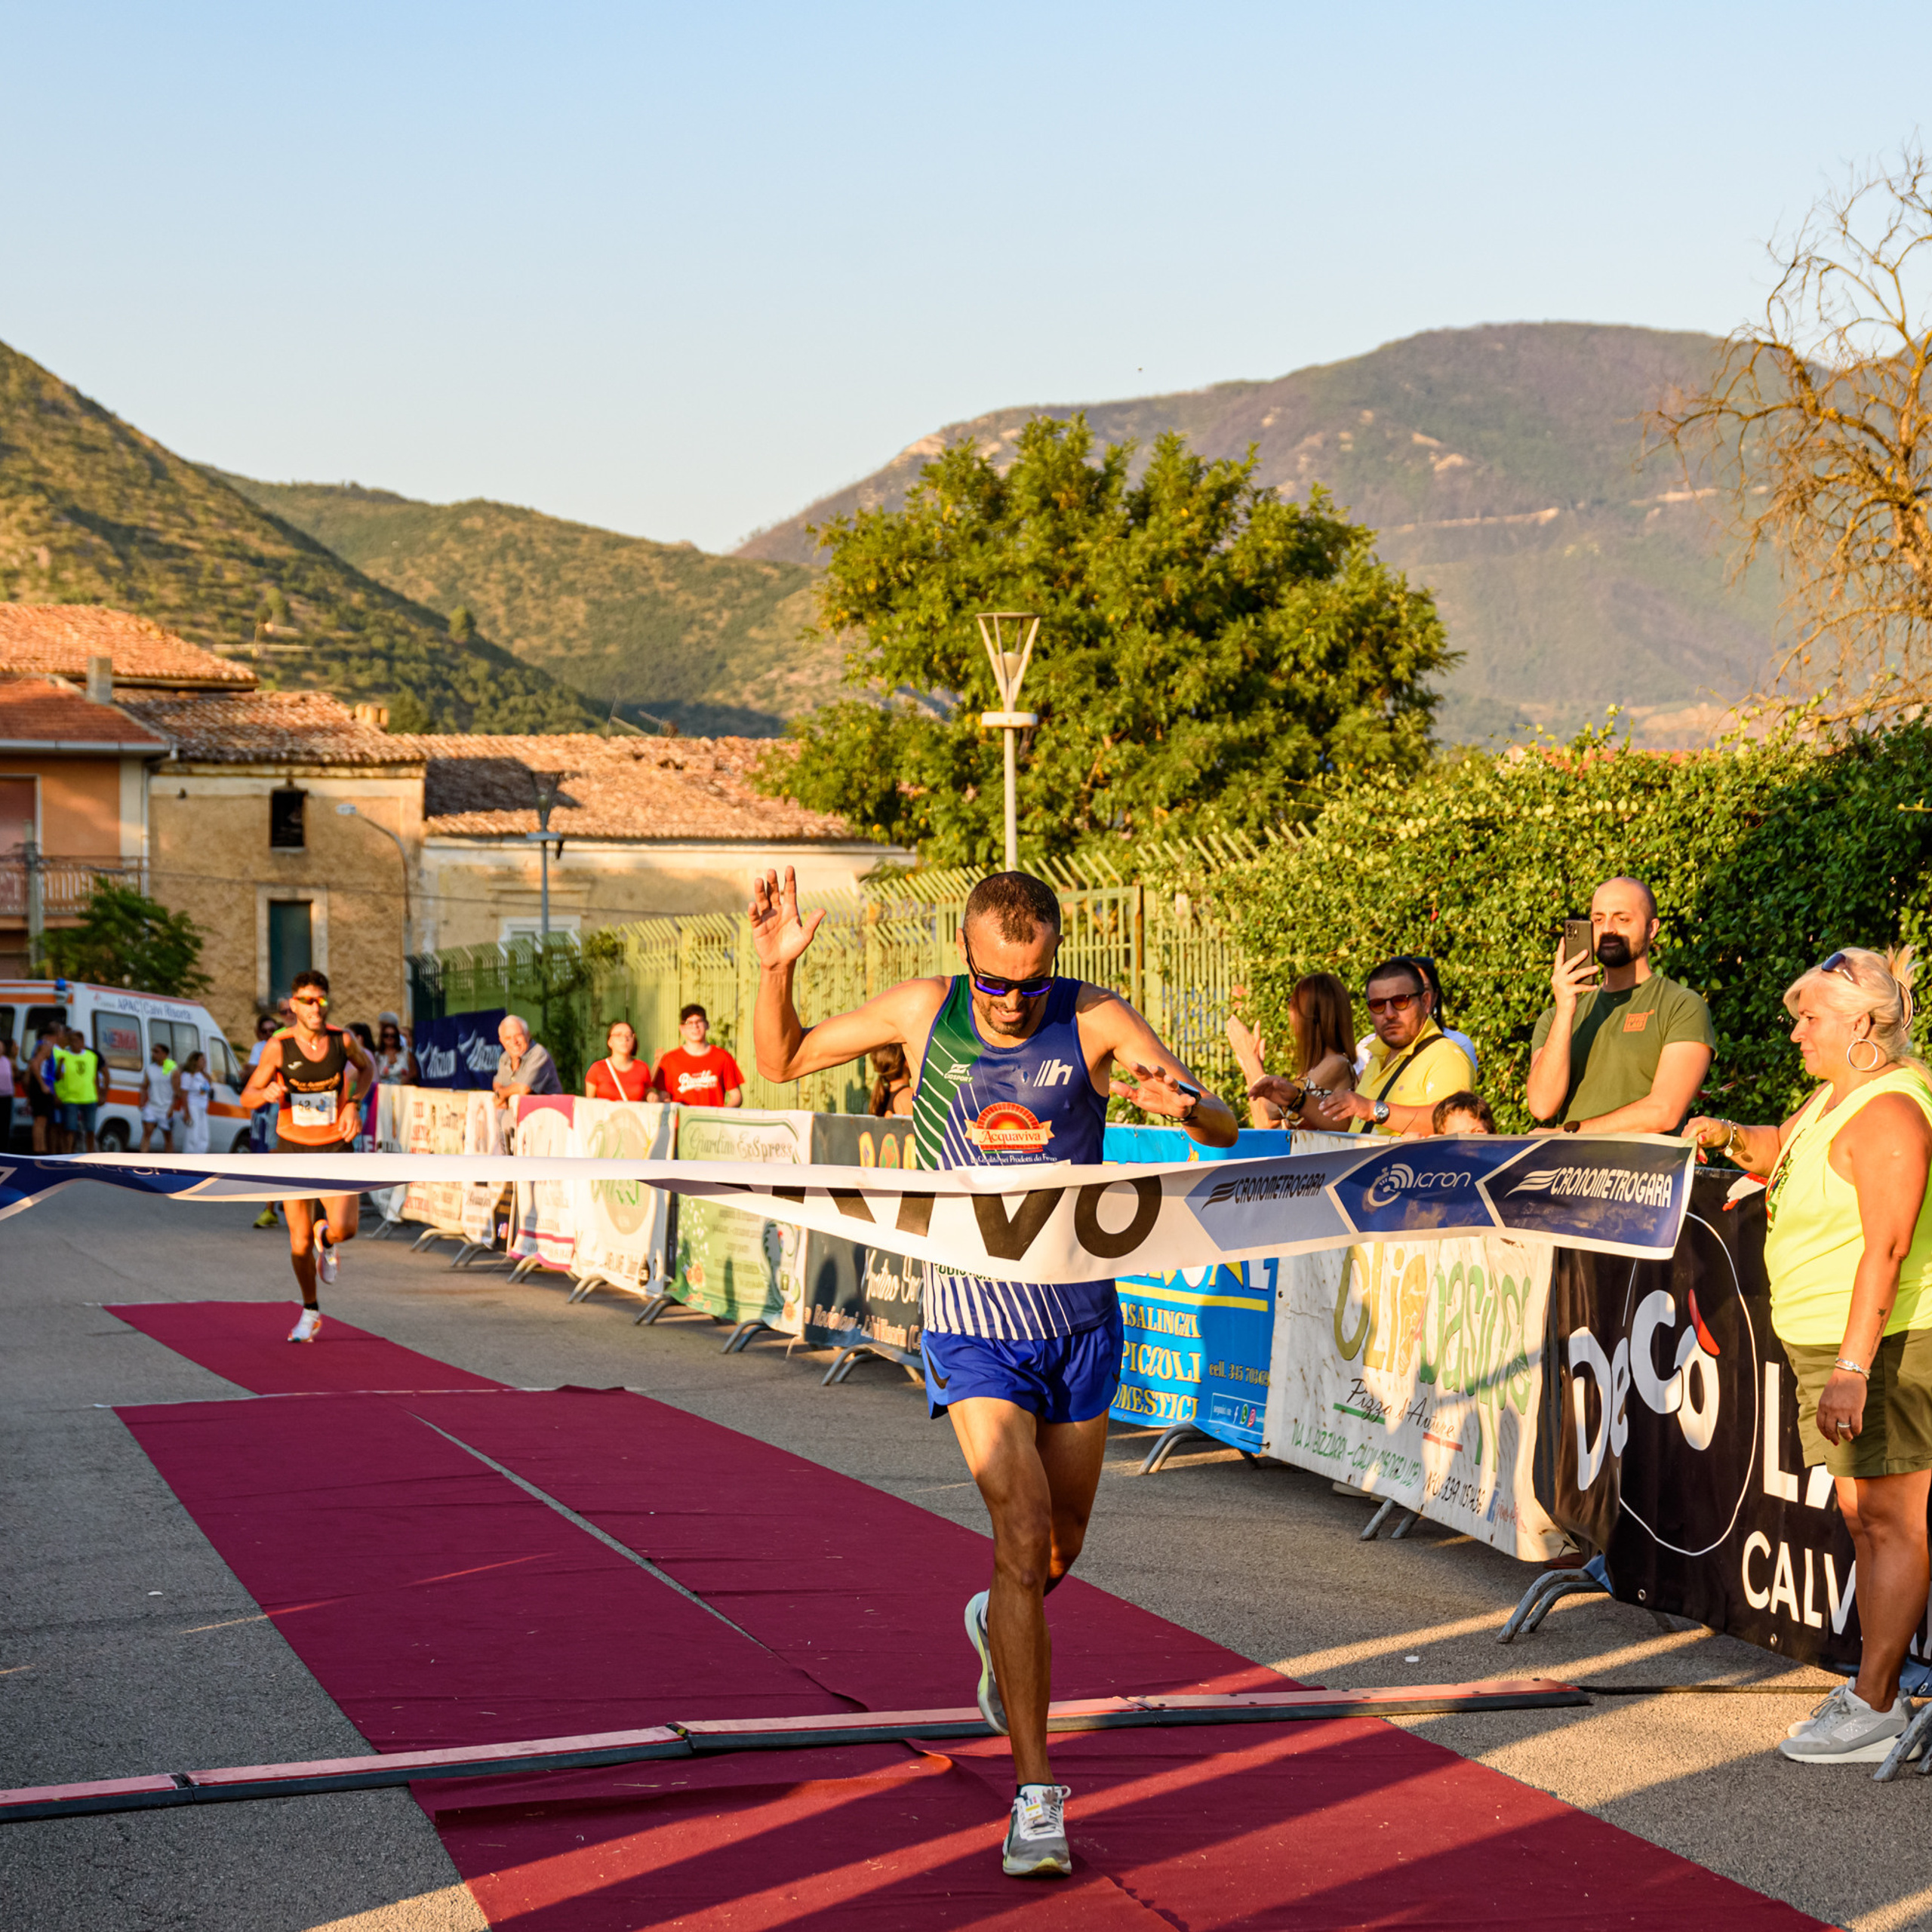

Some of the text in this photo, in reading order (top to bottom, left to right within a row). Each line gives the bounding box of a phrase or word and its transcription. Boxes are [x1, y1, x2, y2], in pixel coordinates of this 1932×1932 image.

[979, 1131, 1041, 1143] Acquaviva
[1234, 1172, 1327, 1204] CRONOMETROGARA
[1413, 1171, 1472, 1189] icron
[1550, 1166, 1673, 1208] CRONOMETROGARA
[1120, 1302, 1202, 1339] ASALINGHI
[1121, 1340, 1202, 1384] PICCOLI
[1209, 1360, 1227, 1378] cell.
[1110, 1383, 1200, 1423] MESTICI
[1346, 1378, 1392, 1421] Pizza
[1441, 1475, 1461, 1503] 339
[1741, 1530, 1858, 1636] CALV
